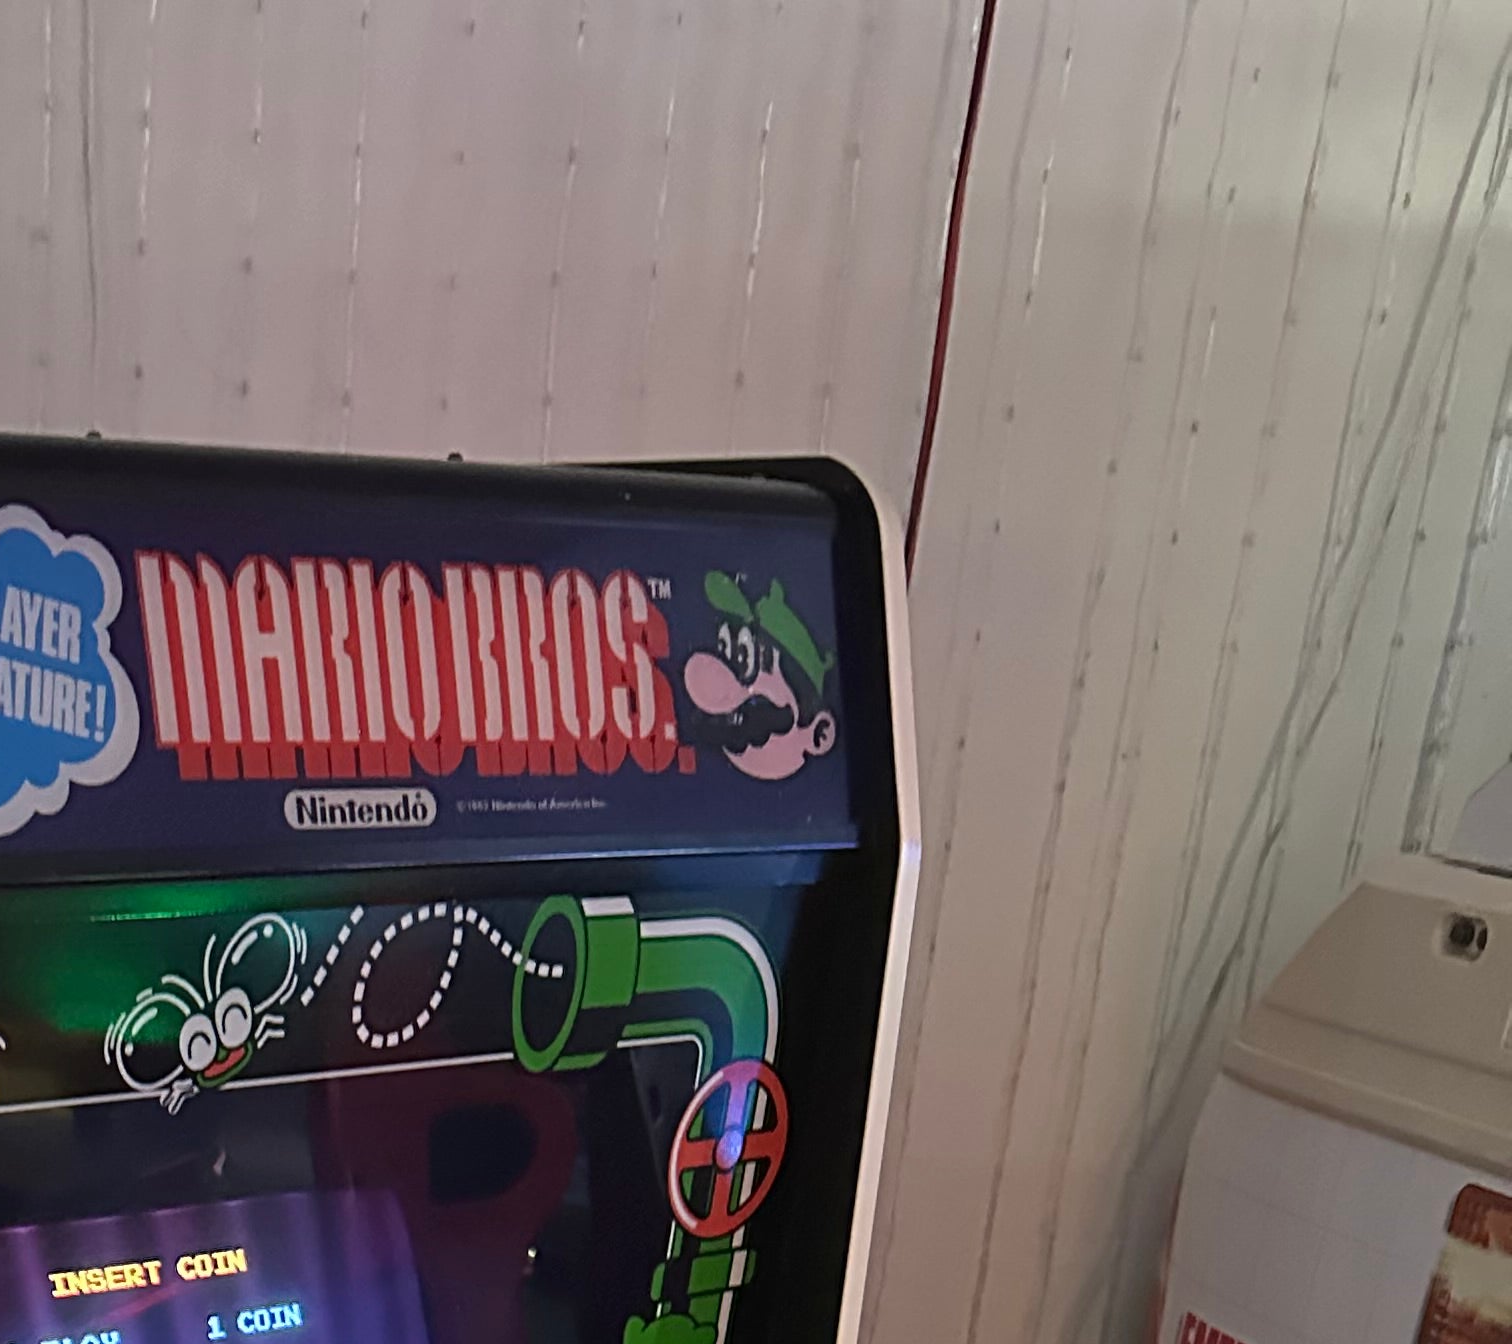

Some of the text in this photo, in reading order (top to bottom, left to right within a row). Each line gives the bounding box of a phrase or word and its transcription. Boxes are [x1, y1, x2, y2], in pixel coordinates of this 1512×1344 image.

[136, 550, 445, 772] MARIO
[295, 791, 429, 826] Nintendo
[48, 1248, 248, 1298] INSERT COIN
[207, 1315, 227, 1340] 1
[237, 1303, 304, 1335] COIN
